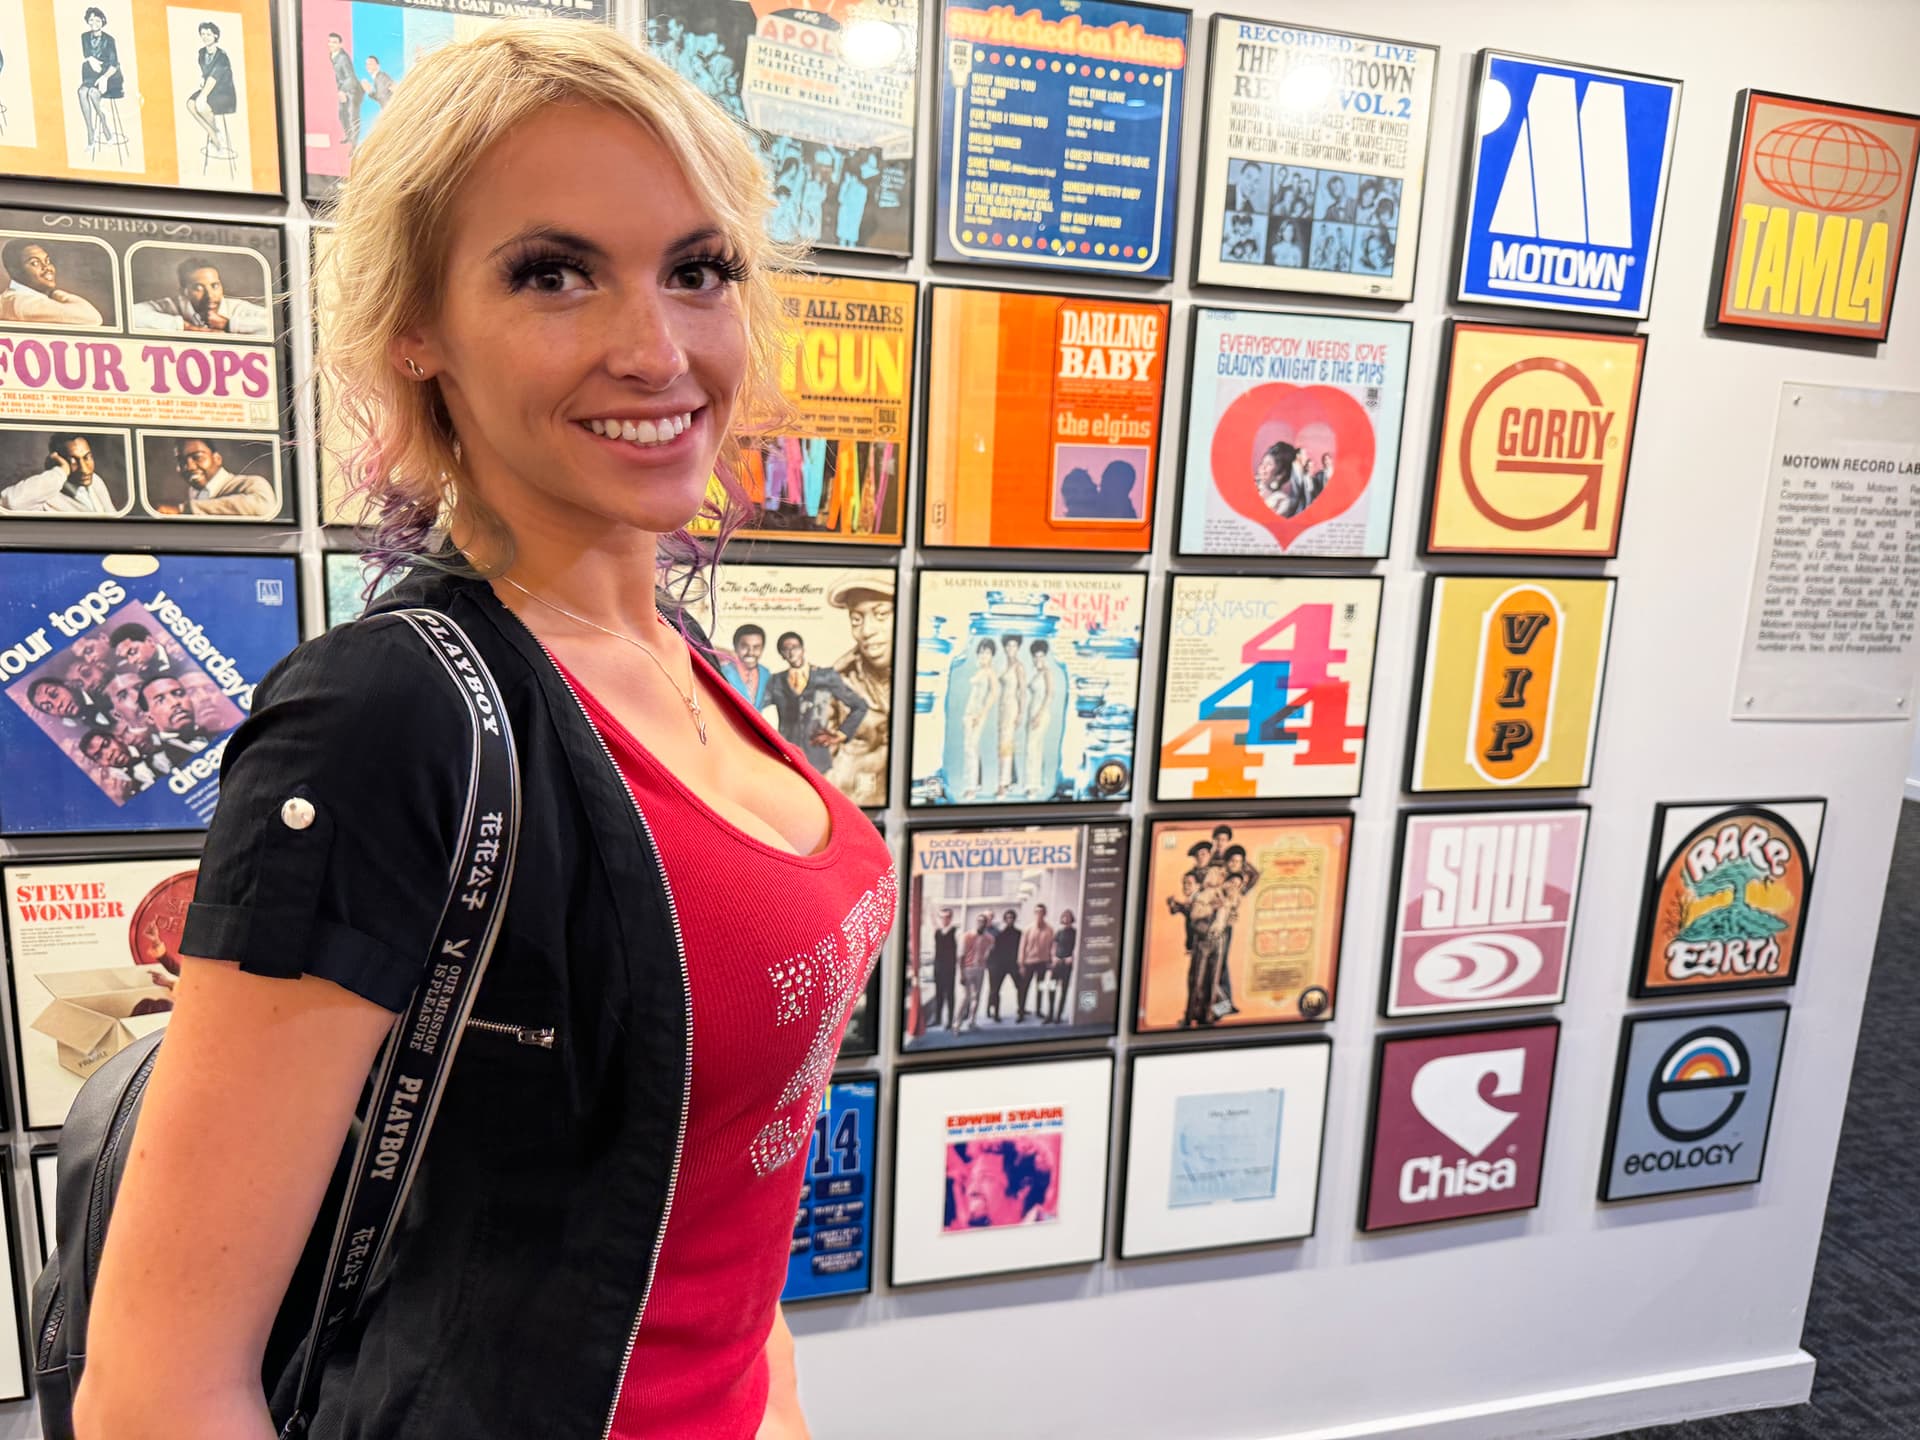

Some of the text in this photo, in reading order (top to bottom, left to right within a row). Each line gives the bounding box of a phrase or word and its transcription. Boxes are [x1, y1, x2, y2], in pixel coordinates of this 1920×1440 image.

[458, 0, 490, 13] CAN
[761, 19, 833, 56] APOL
[949, 7, 1183, 67] switched on blues
[1239, 24, 1418, 63] RECORDED LIVE
[758, 45, 825, 69] MIRACLES
[1238, 43, 1279, 73] THE
[79, 216, 158, 235] STEREO
[1488, 240, 1628, 292] MOTOWN
[1734, 202, 1889, 324] TAMLA
[805, 299, 841, 321] ALL
[845, 304, 904, 325] STARS
[1061, 309, 1158, 349] DARLING
[773, 328, 905, 399] TGUN
[1058, 346, 1158, 381] BABY
[1219, 332, 1389, 364] EVERYBODY NEEDS LOVE
[142, 345, 270, 398] TOPS
[1217, 352, 1385, 385] GLADYS KNIGHT & THE PIPS
[1057, 411, 1151, 444] the elgins
[1497, 407, 1615, 460] GORDY
[1782, 454, 1840, 471] MOTOWN
[1842, 459, 1895, 473] RECORD
[720, 581, 741, 593] The
[1177, 583, 1203, 601] best
[49, 578, 127, 637] tops
[1193, 599, 1279, 620] FANTASTIC
[1241, 604, 1348, 690] 4
[414, 613, 500, 737] PLAYBOY
[1484, 612, 1550, 762] VIP
[168, 733, 234, 795] drea
[1159, 718, 1264, 799] 4
[461, 811, 503, 911] 花花公子
[919, 845, 1072, 870] VANCOUVERS
[929, 838, 972, 850] bobby
[16, 882, 106, 903] STEVIE
[1420, 823, 1554, 930] SOUL
[20, 901, 125, 922] WONDER
[409, 962, 449, 1050] IS PLEASURE
[422, 965, 462, 1055] OUR MISSION
[370, 1074, 424, 1180] PLAYBOY
[947, 1107, 1063, 1128] EDWIN STARR
[811, 1108, 860, 1177] 14
[1399, 1155, 1517, 1204] Chisa
